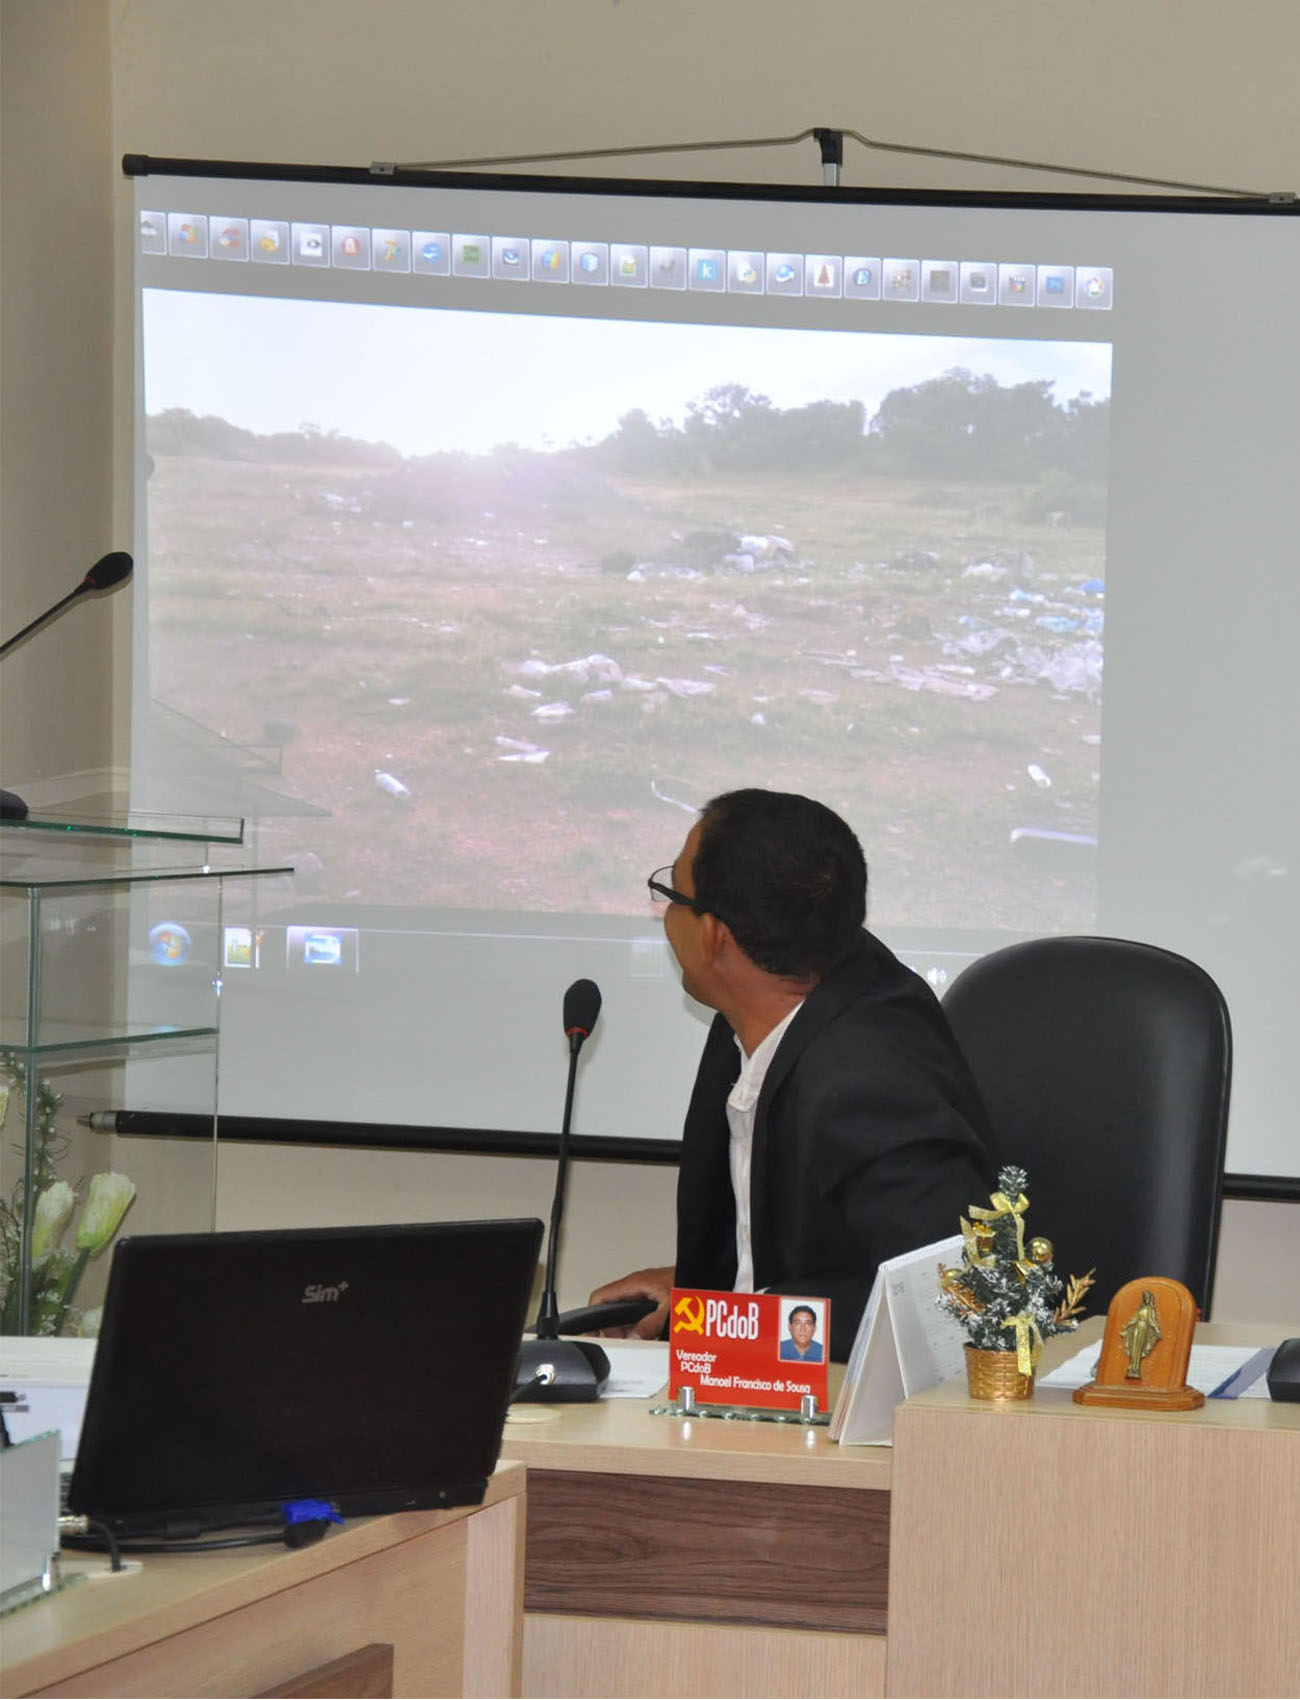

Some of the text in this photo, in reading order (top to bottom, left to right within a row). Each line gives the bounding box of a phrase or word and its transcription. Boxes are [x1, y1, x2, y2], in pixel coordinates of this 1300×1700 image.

[705, 1299, 760, 1340] PCdoB
[676, 1349, 718, 1363] Vereador
[680, 1361, 712, 1374] PCdoB
[700, 1374, 811, 1394] Manoel Francisco de Sousa
